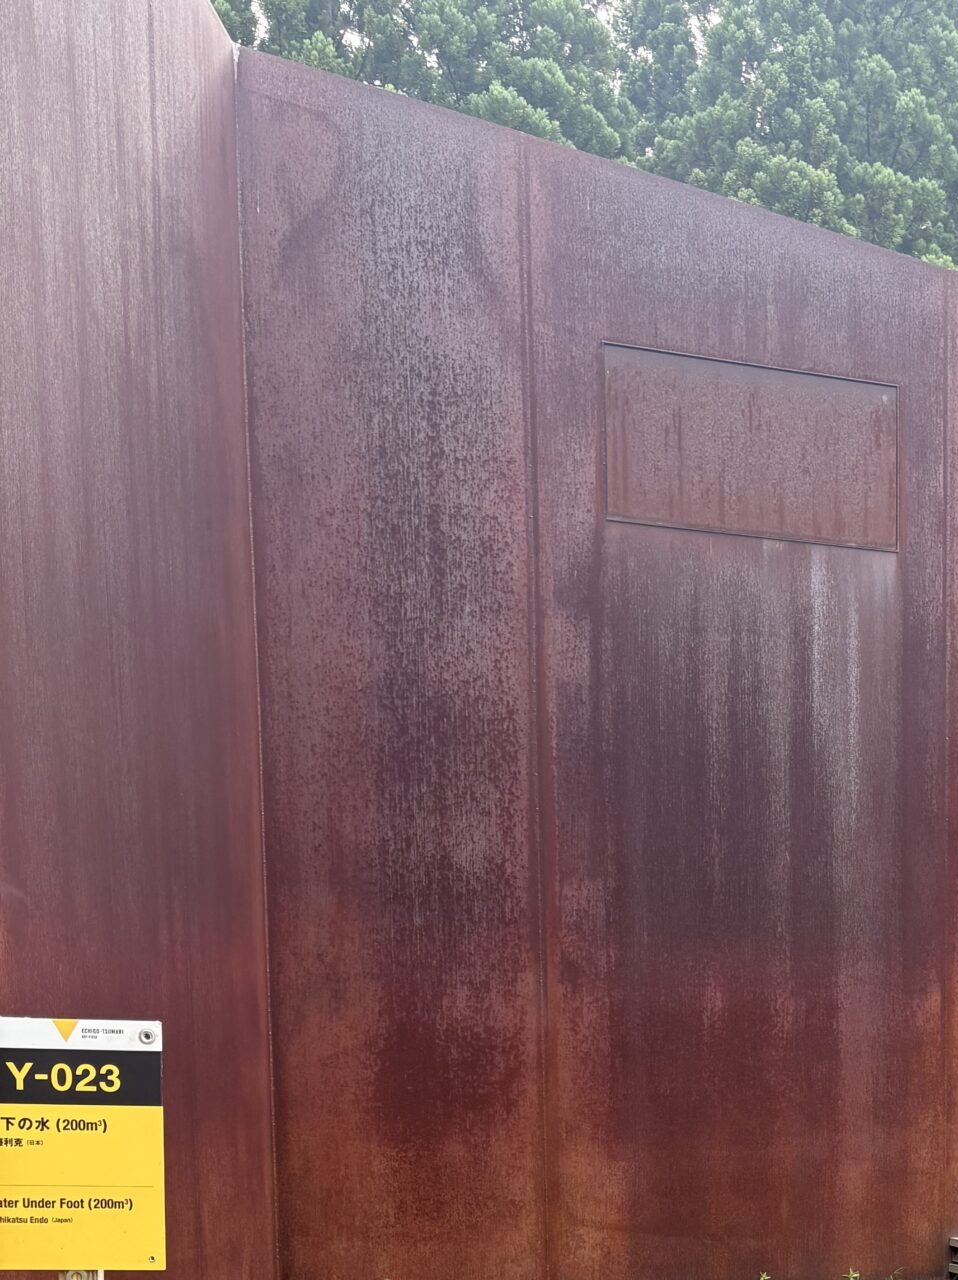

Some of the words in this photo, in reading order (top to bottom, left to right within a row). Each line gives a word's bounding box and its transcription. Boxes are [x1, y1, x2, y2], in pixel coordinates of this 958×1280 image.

[5, 1061, 121, 1092] Y-023
[0, 1117, 50, 1131] 下の水
[22, 1198, 56, 1209] Under
[59, 1198, 85, 1209] Foot
[30, 1216, 49, 1224] Endo
